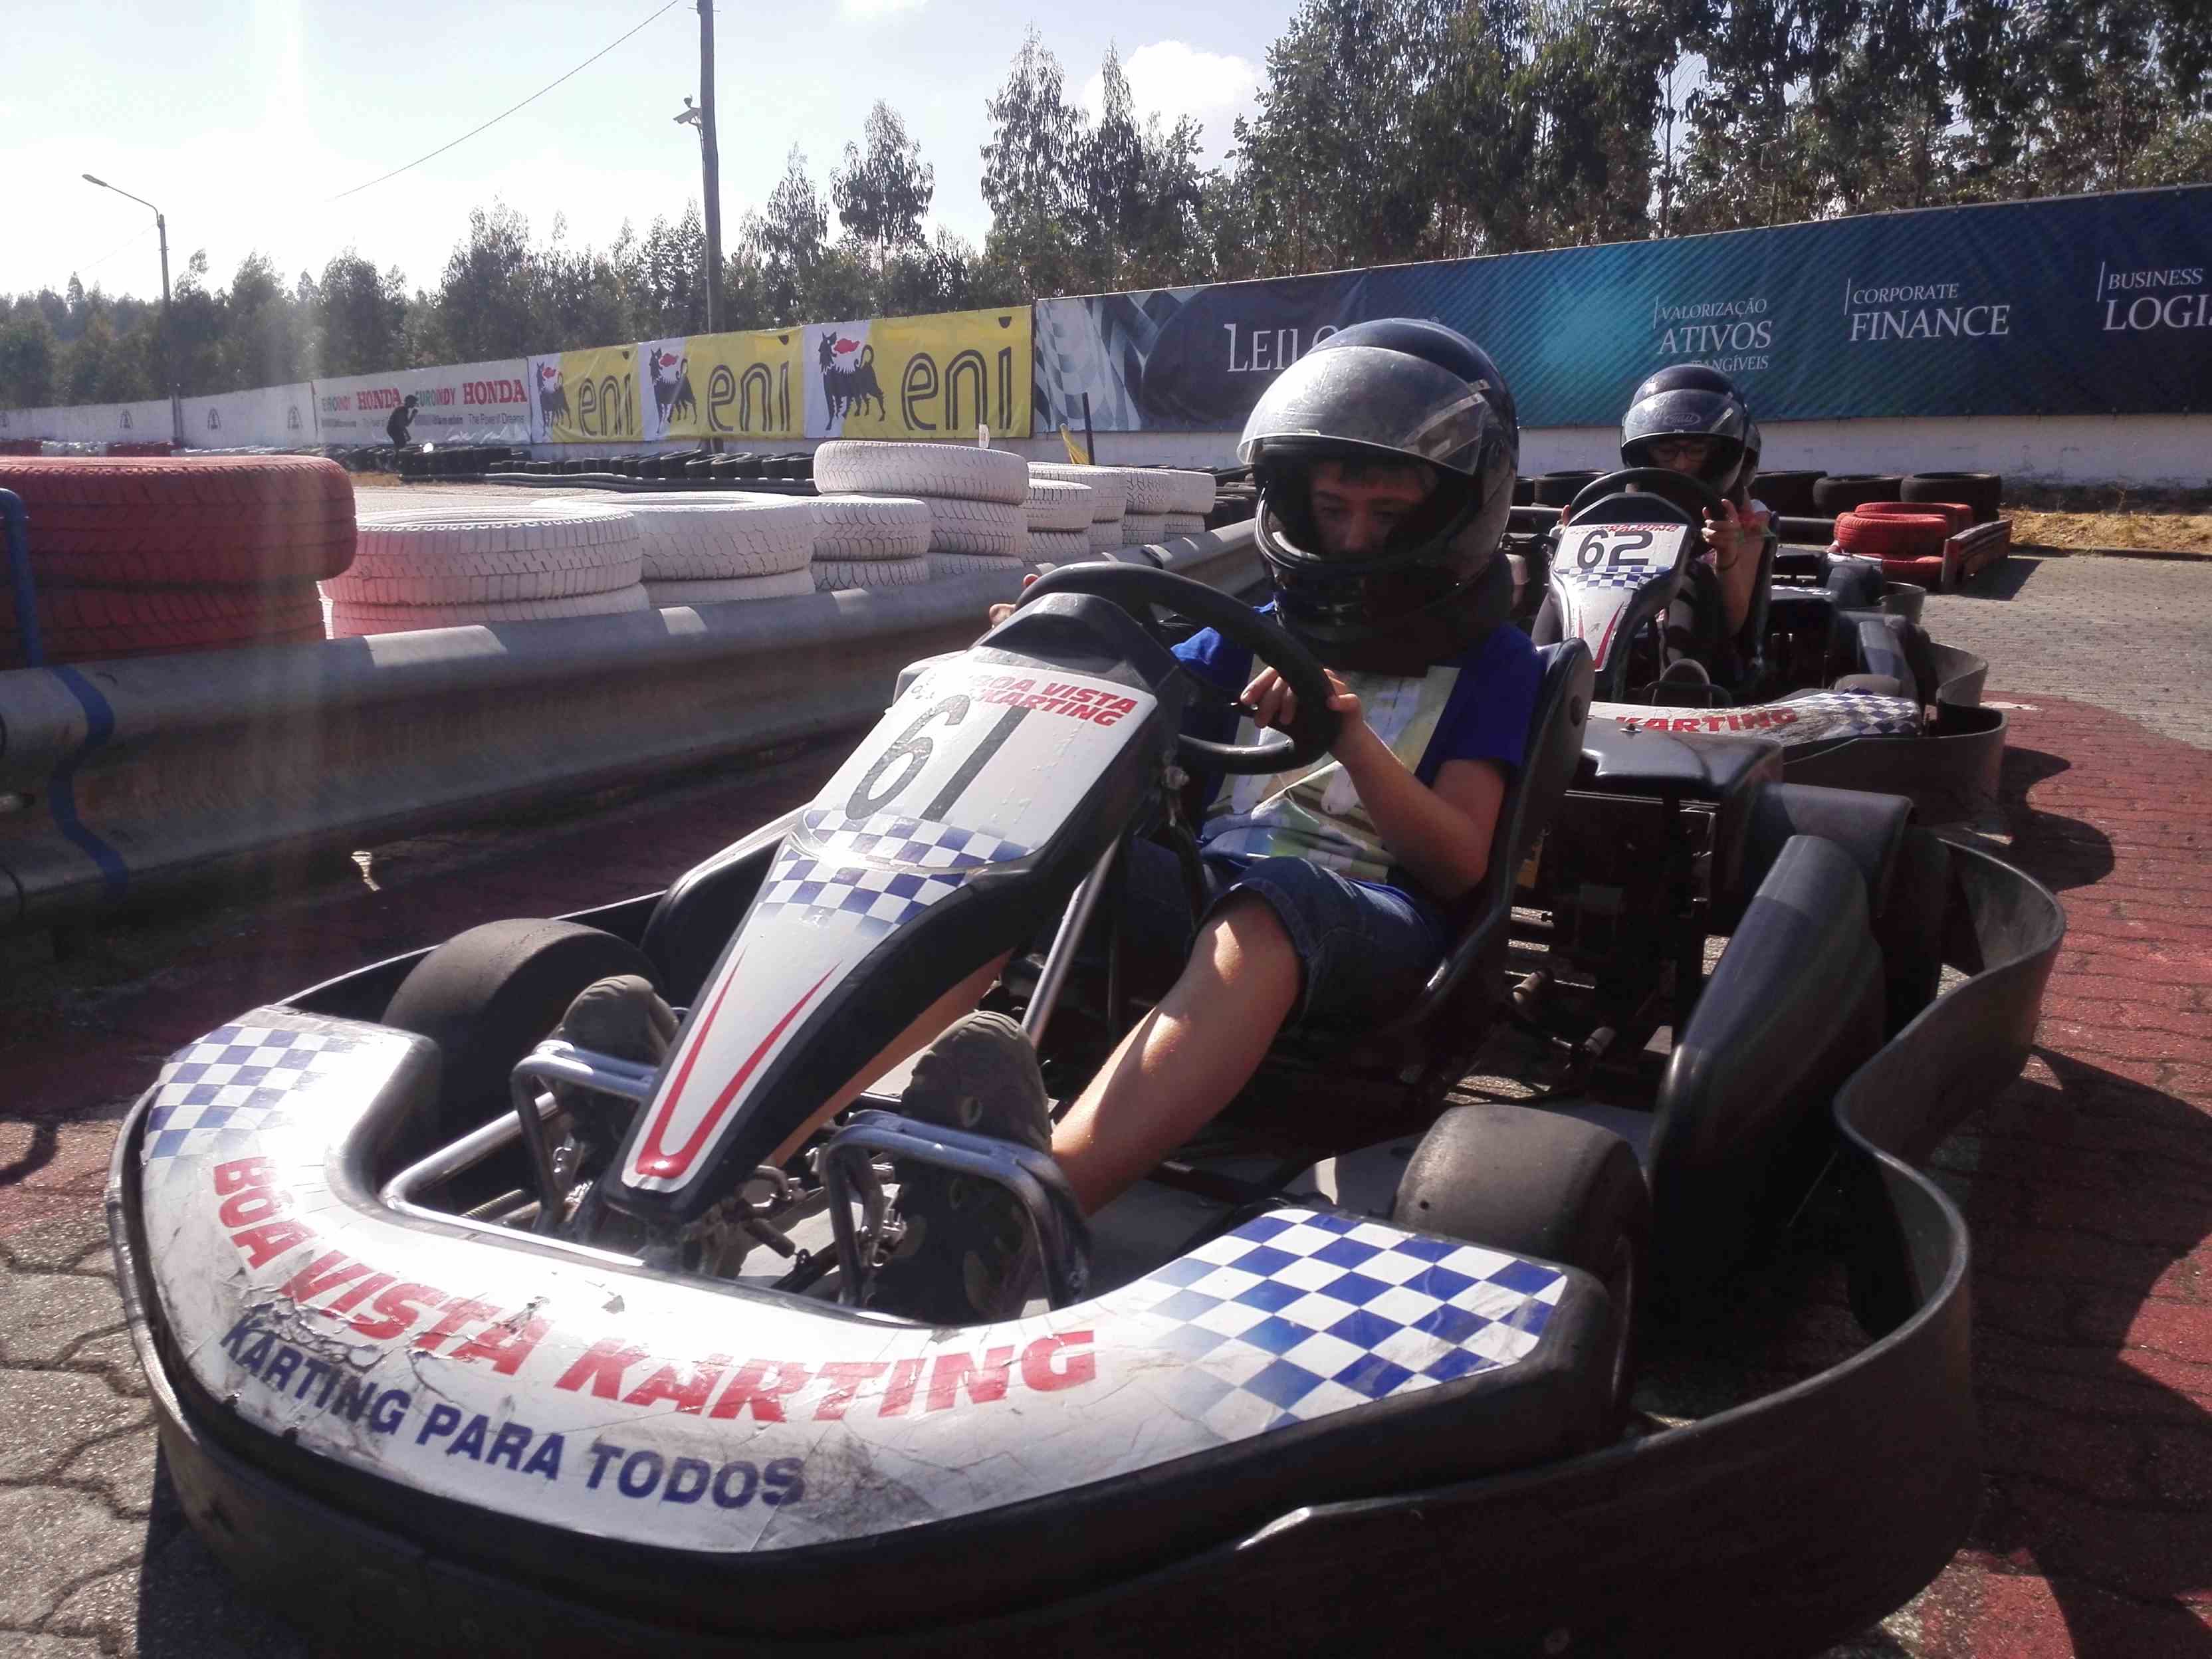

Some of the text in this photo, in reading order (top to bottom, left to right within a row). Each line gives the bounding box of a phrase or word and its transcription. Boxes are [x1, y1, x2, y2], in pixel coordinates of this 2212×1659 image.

[1852, 283, 1959, 304] CORPORATE
[2107, 268, 2203, 290] BUSINESS
[1662, 298, 1767, 320] VALORIZAÇÃO
[1850, 305, 2011, 341] FINANCE
[2102, 294, 2212, 330] LOGI
[1656, 320, 1773, 355] ATIVOS
[707, 334, 790, 432] eni
[901, 316, 1012, 431] eni
[356, 388, 403, 410] HONDA
[462, 379, 527, 405] HONDA
[578, 350, 633, 436] eni
[1577, 529, 1653, 570] 62
[981, 689, 1125, 727] KARTING
[1042, 682, 1139, 713] VISTA
[845, 694, 1032, 823] 61
[213, 1157, 1095, 1423] BOA VISTA KARTING
[219, 1303, 806, 1509] KARTING PARA TODOS
